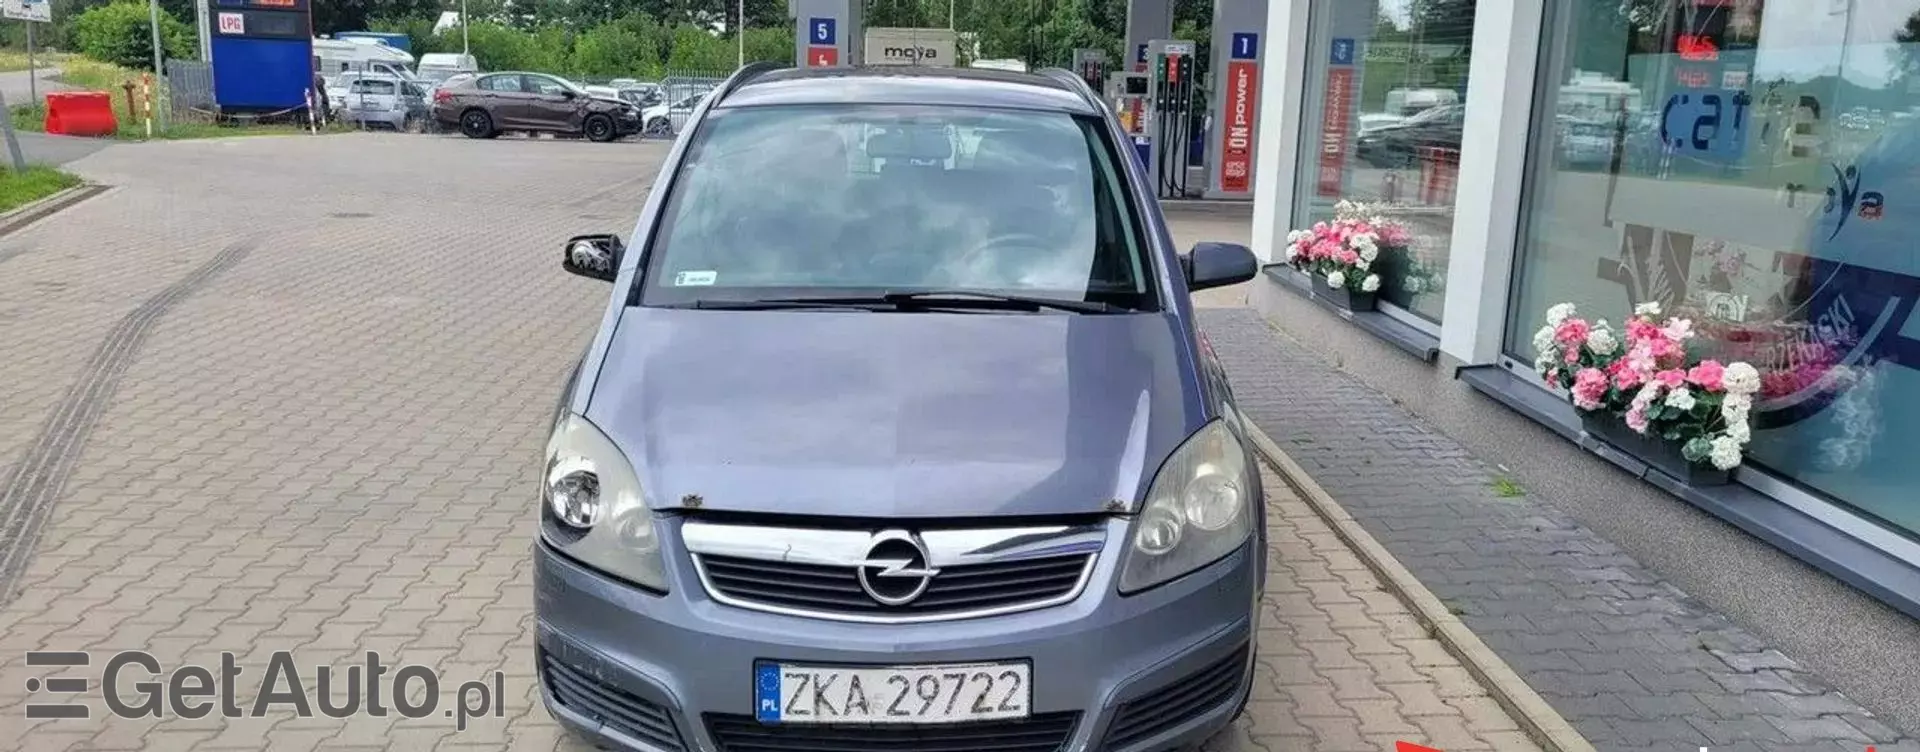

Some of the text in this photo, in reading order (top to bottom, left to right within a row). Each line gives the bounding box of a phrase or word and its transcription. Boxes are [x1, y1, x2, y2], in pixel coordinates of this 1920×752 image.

[222, 16, 241, 30] LPG
[817, 23, 828, 40] 5
[884, 44, 937, 61] moya
[1241, 37, 1249, 55] 1
[1235, 68, 1249, 126] power
[784, 673, 869, 716] ZKA
[886, 670, 1021, 716] 29722
[762, 699, 778, 712] PL
